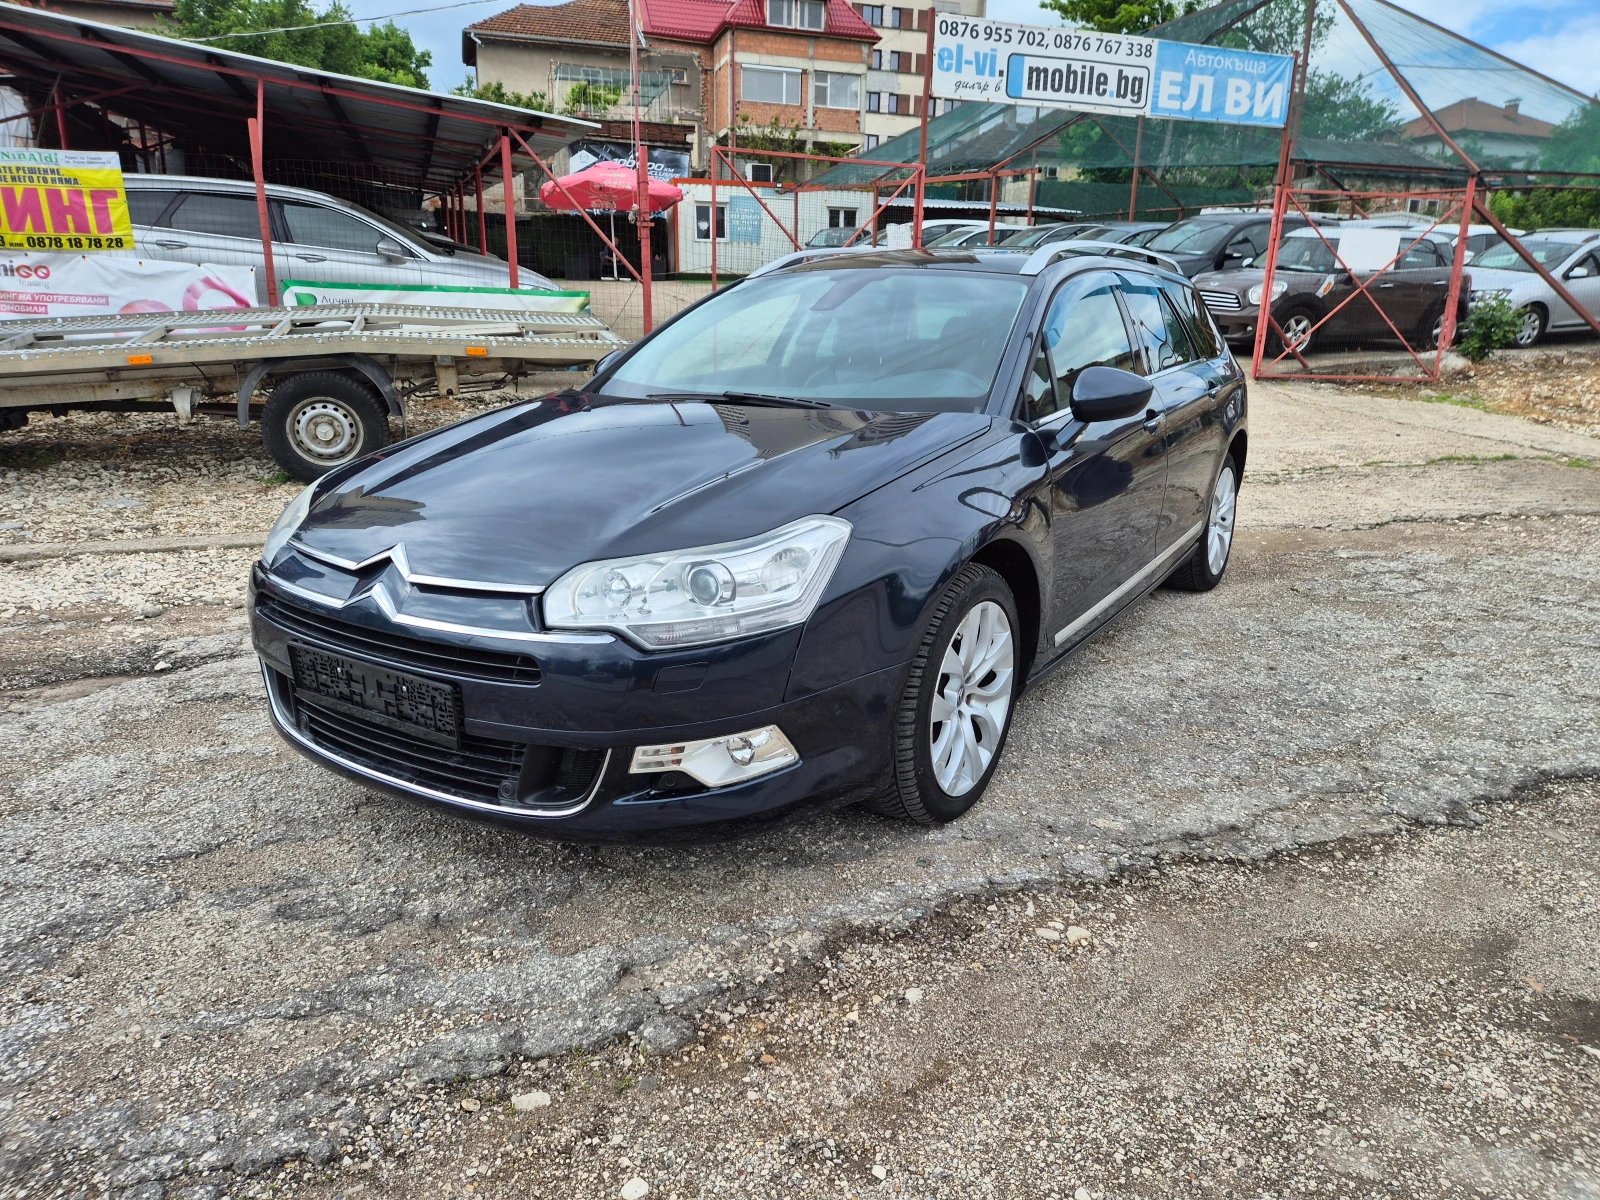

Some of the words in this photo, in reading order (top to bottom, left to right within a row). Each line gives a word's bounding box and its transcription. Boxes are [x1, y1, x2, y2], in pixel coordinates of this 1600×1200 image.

[939, 19, 980, 40] 0876
[983, 25, 1013, 44] 955
[1017, 29, 1049, 50] 702,
[1054, 33, 1091, 51] 0876
[1095, 38, 1123, 55] 767
[1125, 42, 1153, 58] 338
[1184, 48, 1267, 76] Автокъща
[1026, 63, 1144, 104] mobile.bg
[1157, 70, 1215, 113] ЕЛ
[1224, 77, 1283, 119] ВИ
[11, 174, 35, 184] НЕГО
[37, 175, 49, 185] ГО
[0, 186, 119, 235] ИНГ
[26, 236, 64, 249] 0878
[66, 237, 83, 249] 18
[85, 237, 103, 249] 78
[105, 237, 124, 249] 28
[19, 278, 51, 290] leasing
[0, 303, 46, 313] ОМОБИЛИ
[19, 293, 32, 302] НА
[34, 294, 107, 305] УПОТРЕБЯВАНИ
